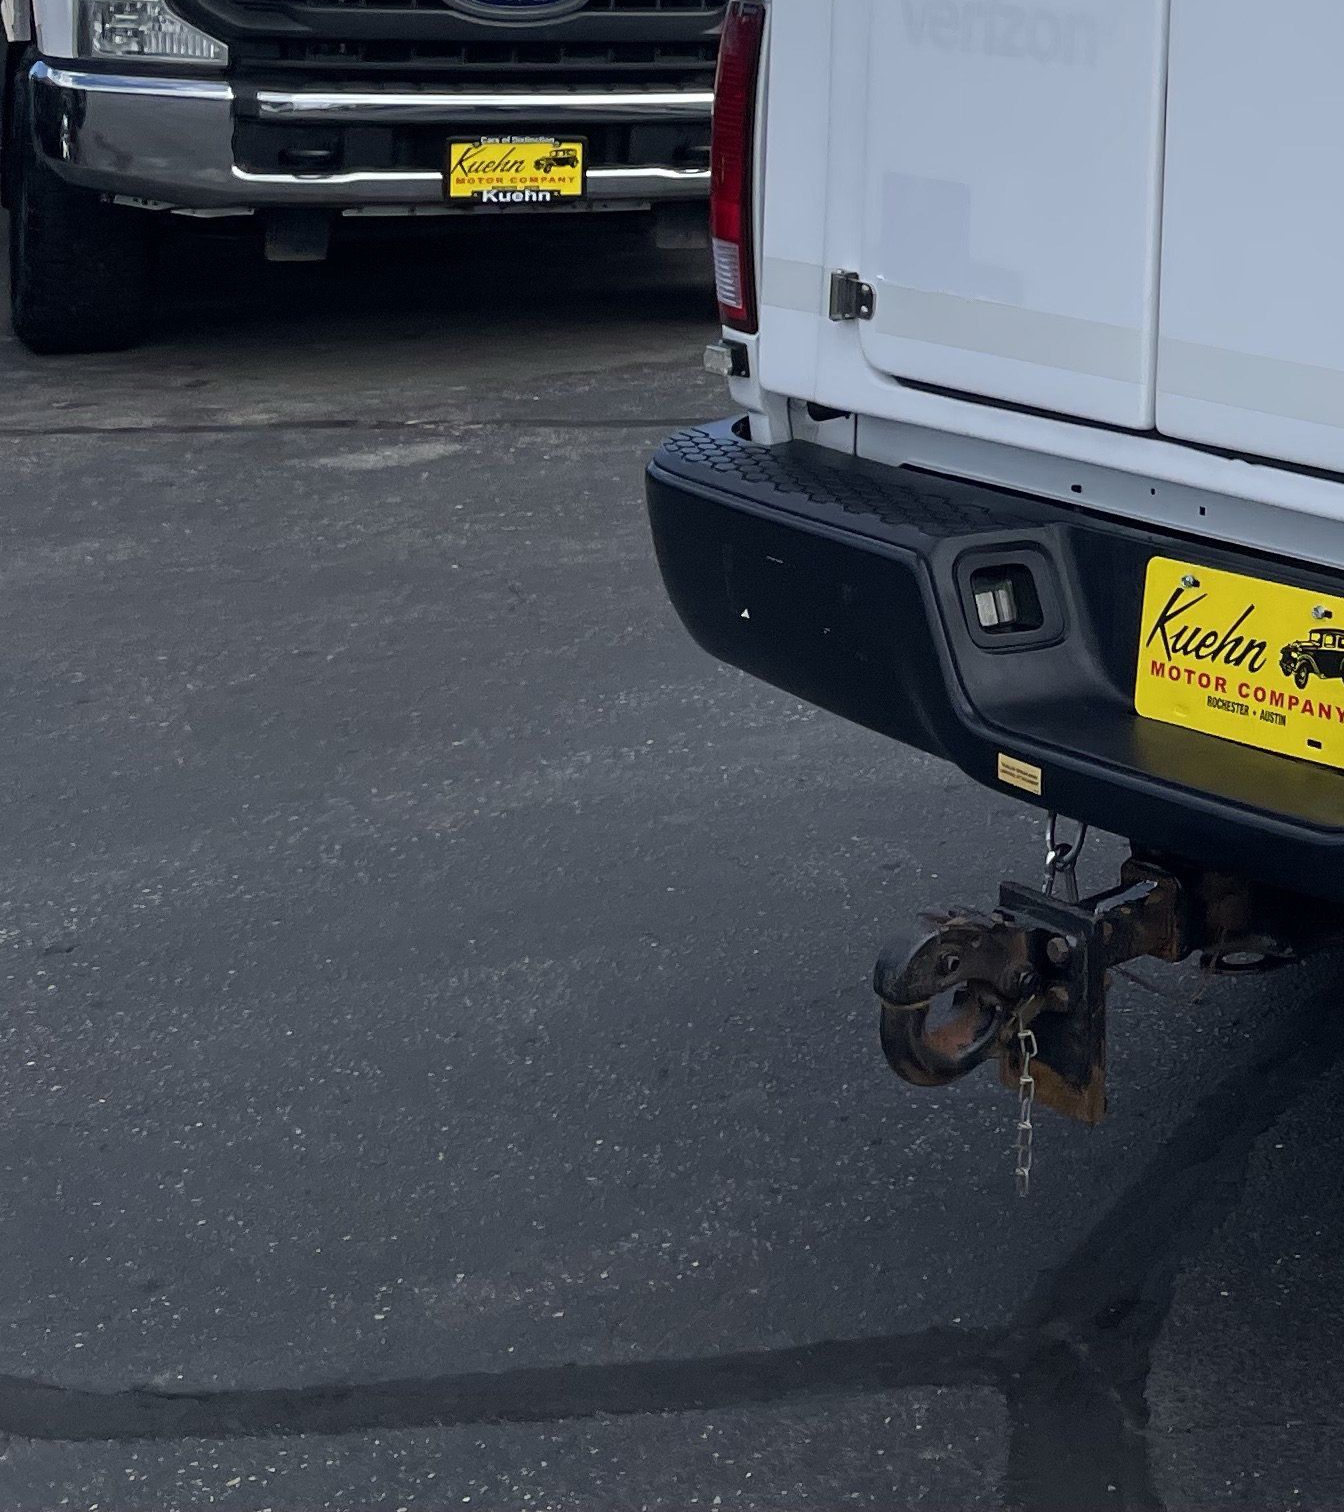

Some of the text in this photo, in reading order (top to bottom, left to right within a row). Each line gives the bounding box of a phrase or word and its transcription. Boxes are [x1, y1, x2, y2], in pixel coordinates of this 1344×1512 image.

[450, 147, 525, 177] Kuehn
[455, 176, 576, 185] MOTOR COMPANY
[482, 191, 551, 202] Kuehn
[1146, 588, 1267, 673] Kuehn
[1150, 660, 1227, 694] MOTOR
[1206, 695, 1288, 727] ROCHESTER AUSTIN
